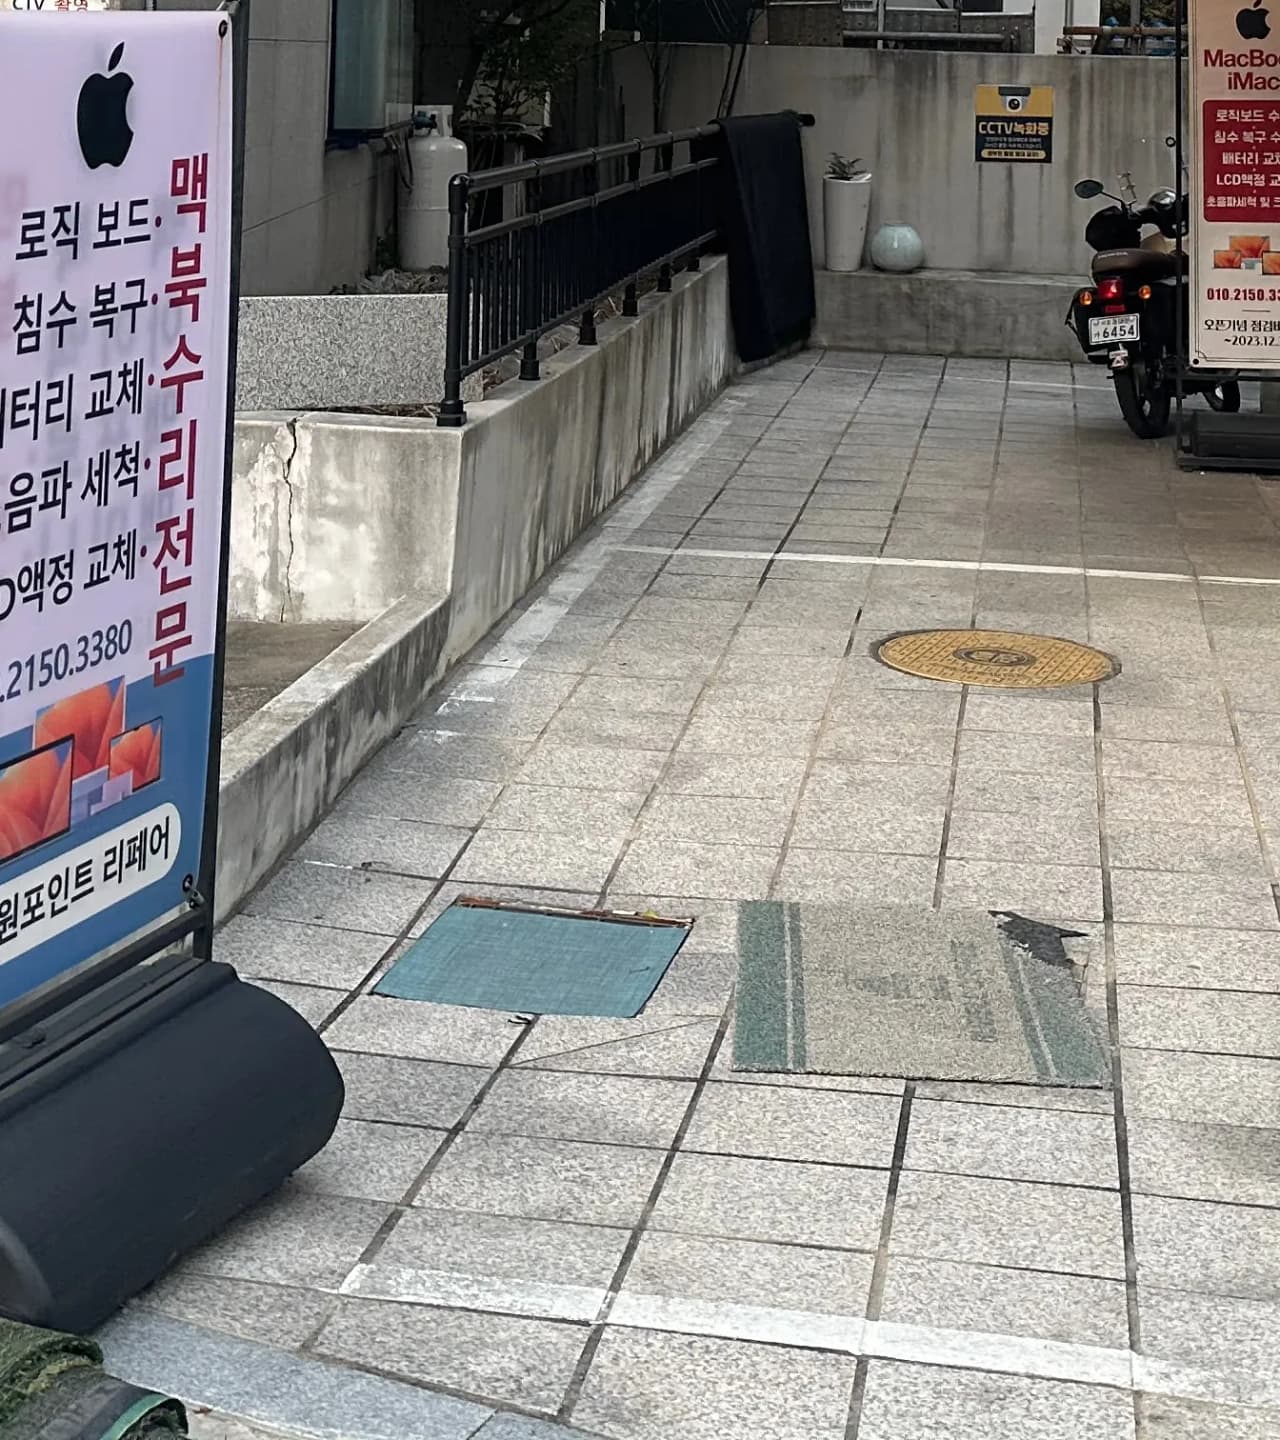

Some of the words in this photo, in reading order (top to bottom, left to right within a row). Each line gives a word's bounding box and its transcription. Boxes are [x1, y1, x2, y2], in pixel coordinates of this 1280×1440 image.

[1228, 71, 1280, 91] iMac
[1216, 109, 1264, 122] 로직보드
[1222, 152, 1259, 165] 배터리
[15, 202, 81, 261] 로직
[93, 198, 152, 249] 보드
[12, 290, 78, 356] 침수
[89, 278, 149, 338] 복구
[1102, 324, 1135, 339] 6454
[1204, 319, 1248, 333] 오픈기념
[85, 357, 144, 421] 교체
[80, 440, 141, 508] 세척
[83, 528, 137, 591] 교체
[102, 816, 171, 884] 리페어
